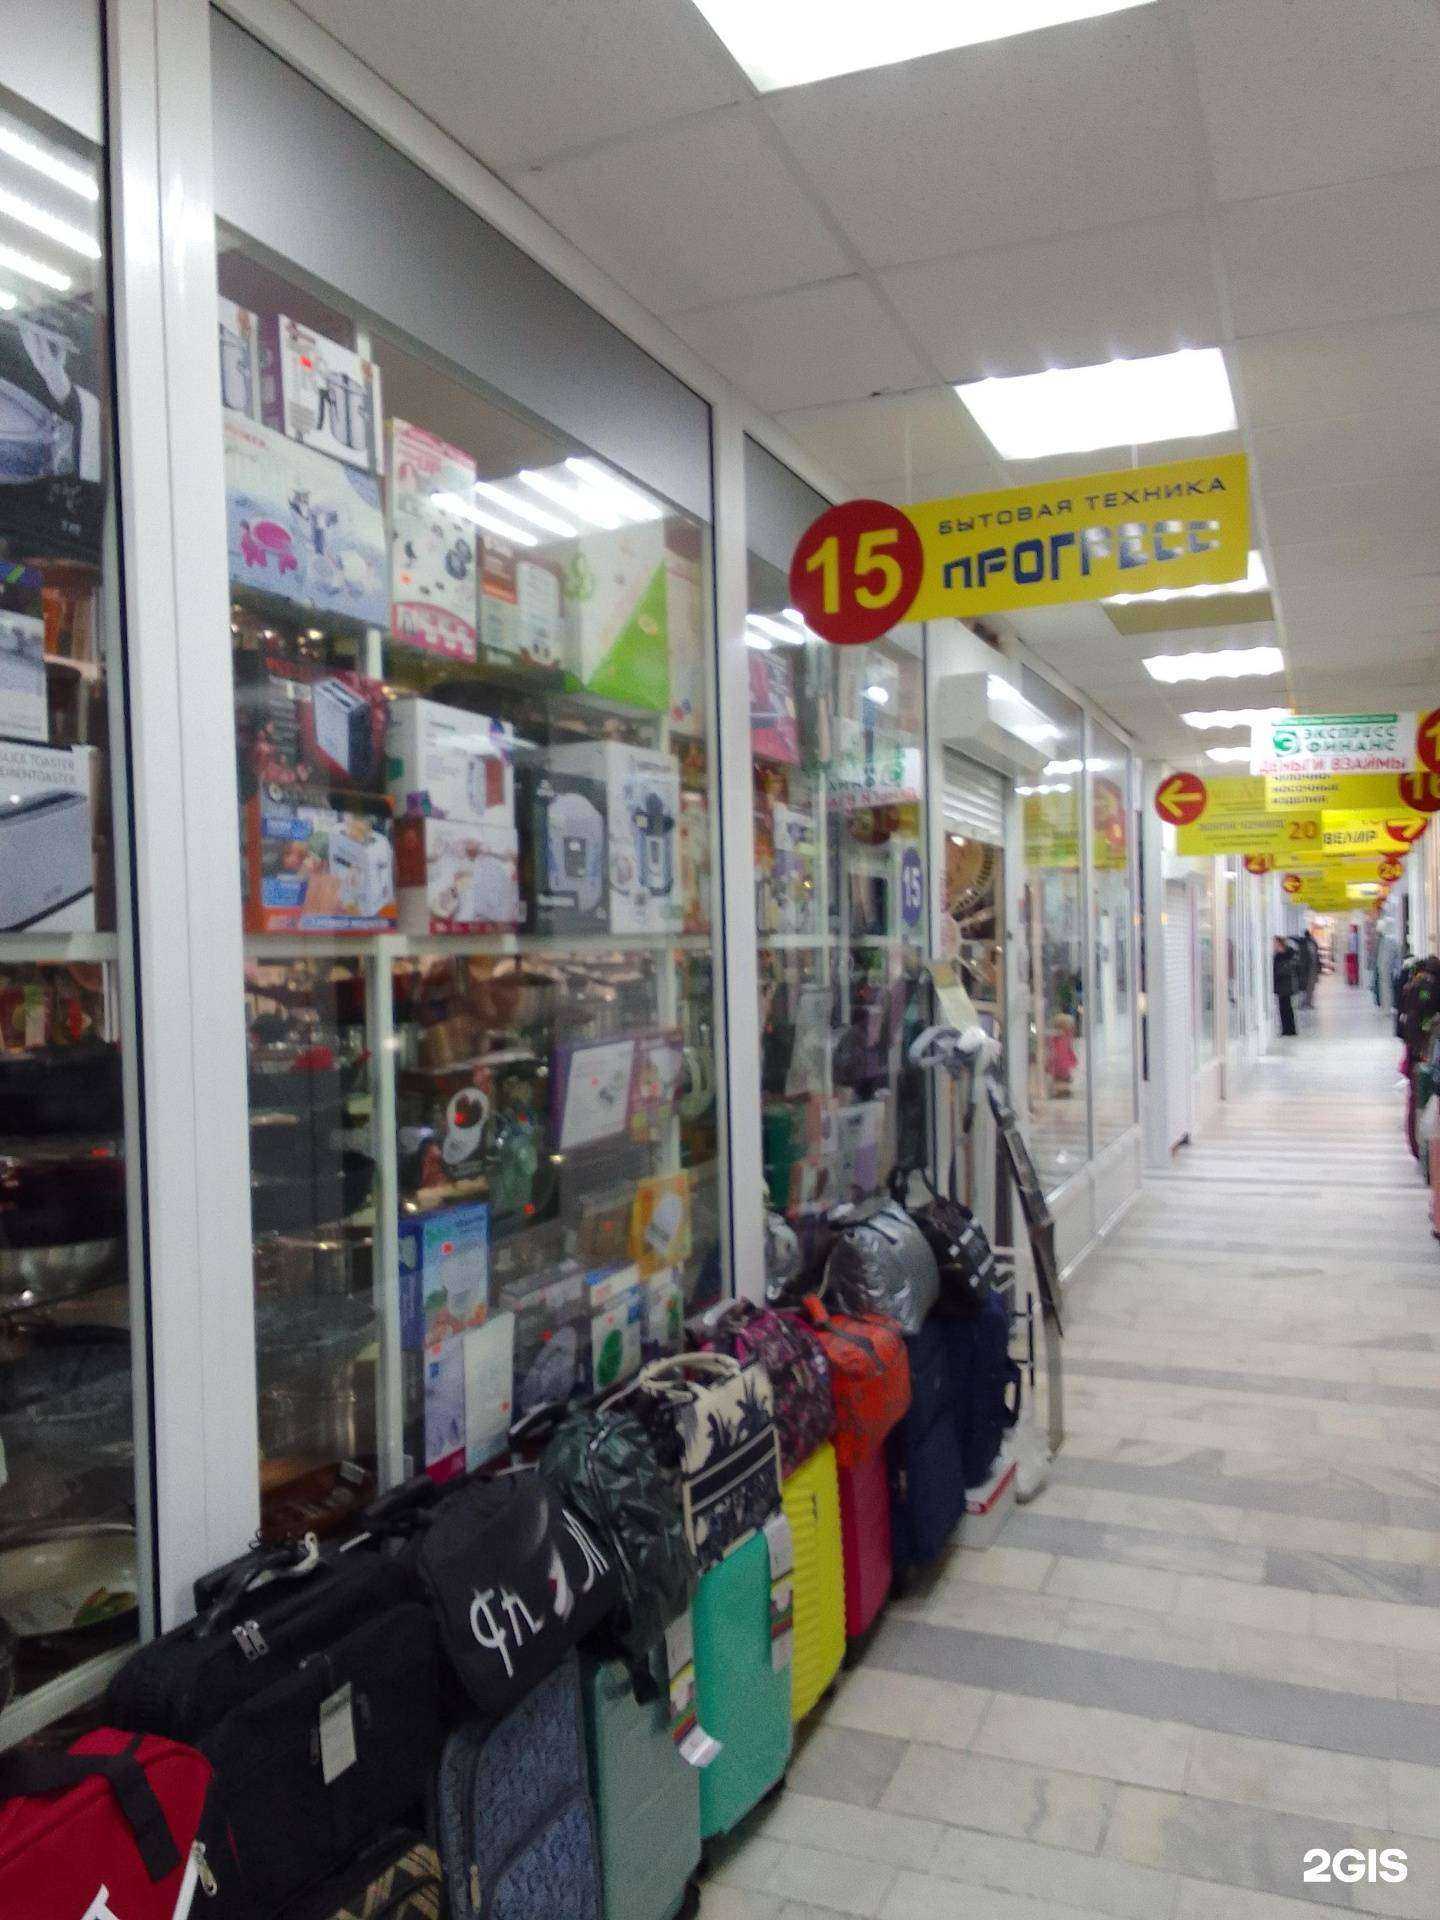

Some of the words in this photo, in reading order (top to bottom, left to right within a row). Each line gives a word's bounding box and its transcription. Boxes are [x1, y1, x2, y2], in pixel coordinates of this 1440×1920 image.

[938, 499, 1073, 535] БЫТОВАЯ
[1085, 476, 1227, 509] ТЕХНИКА
[805, 529, 902, 615] 15
[943, 519, 1221, 589] ПРОГРЕСС
